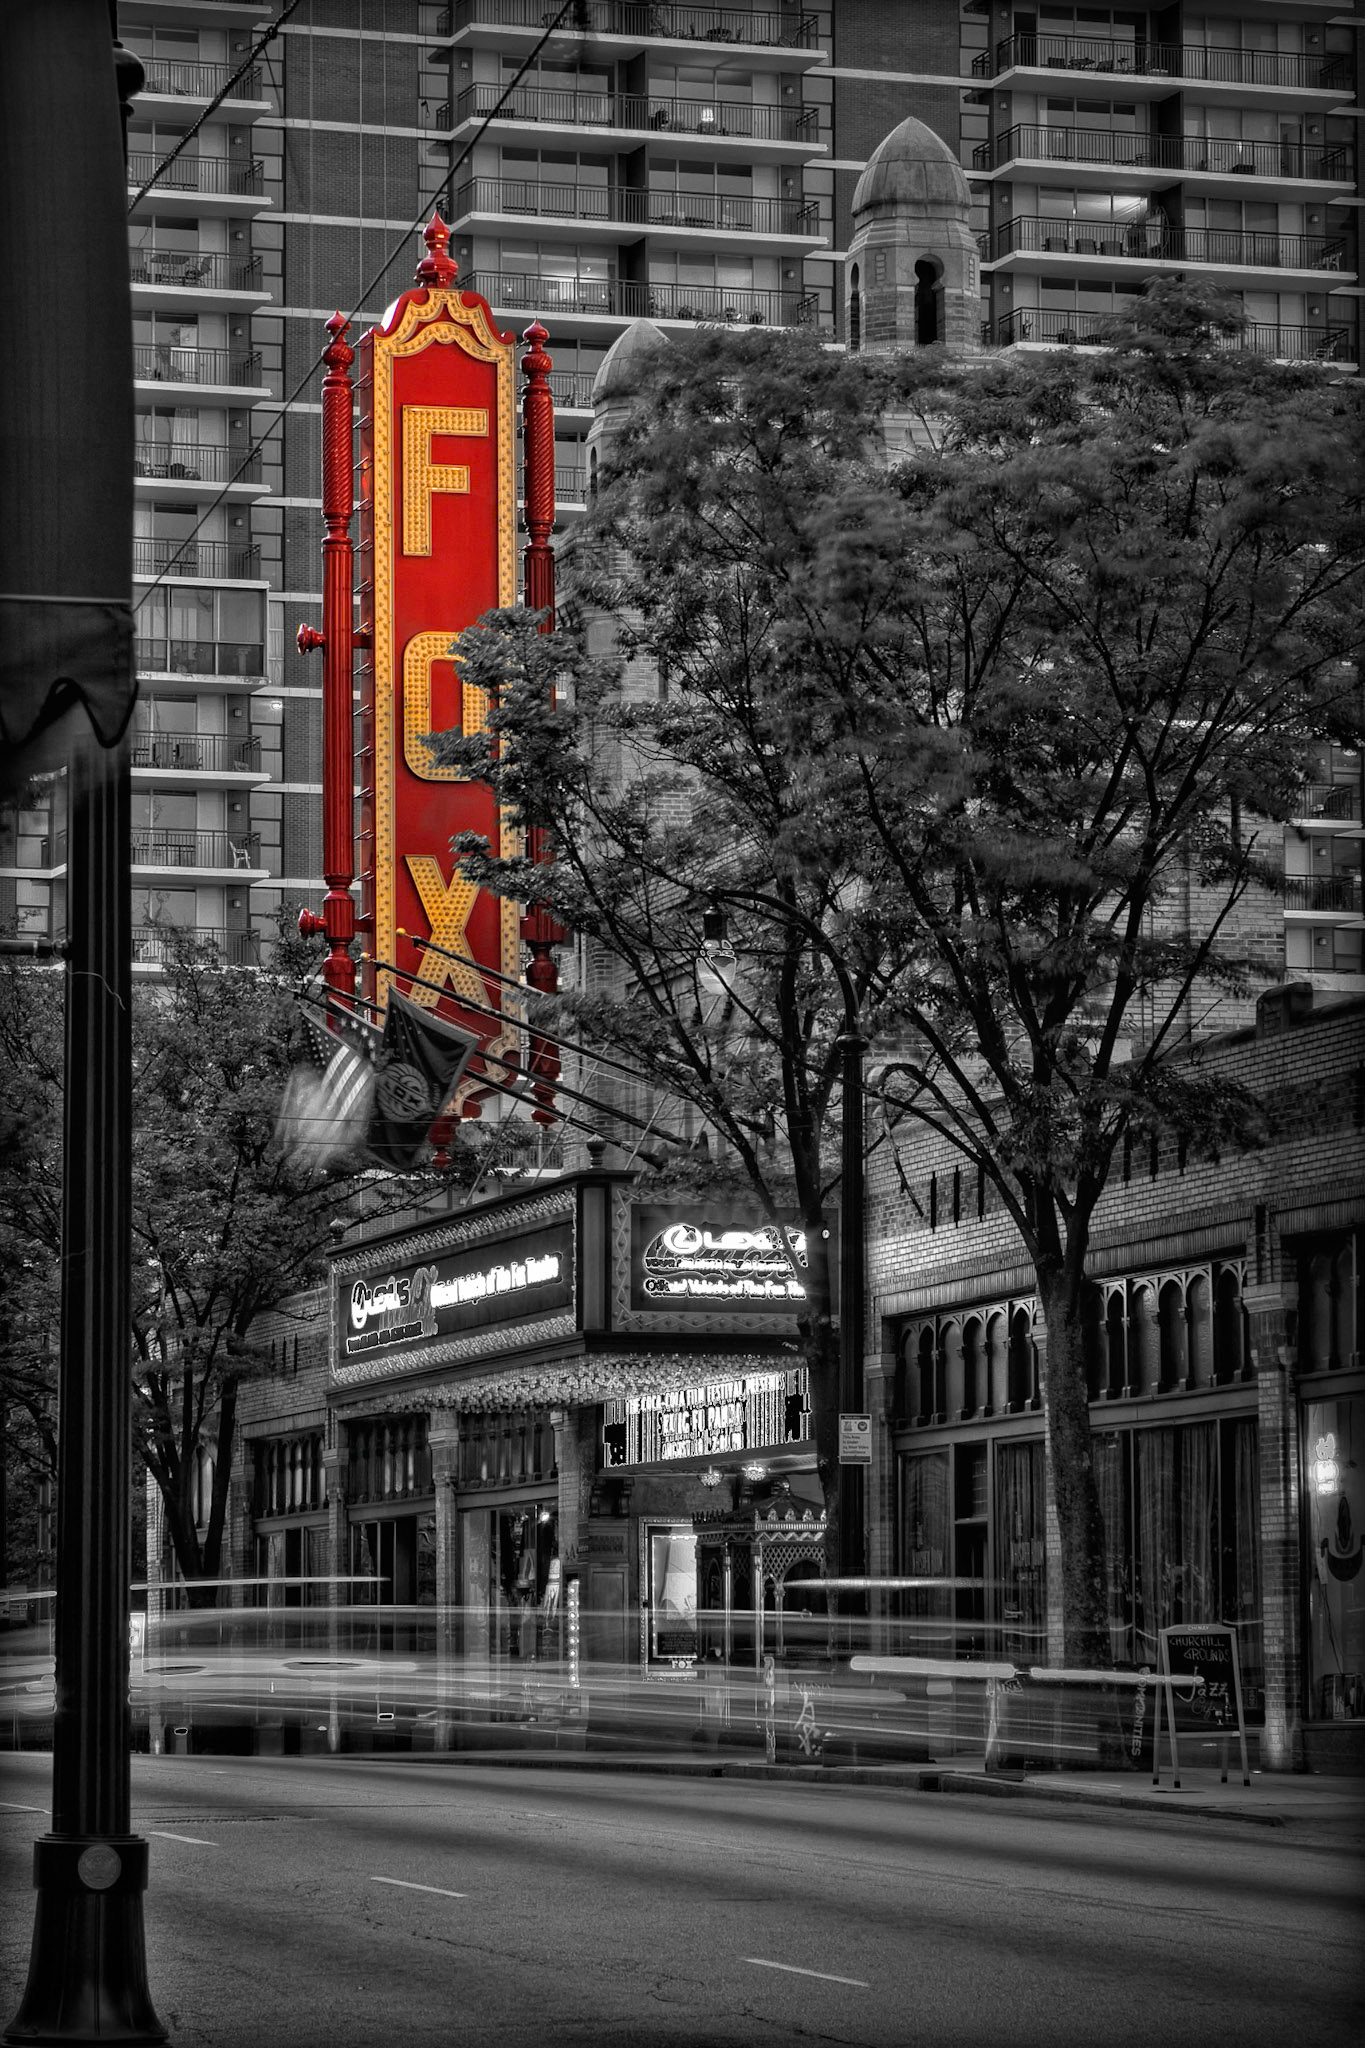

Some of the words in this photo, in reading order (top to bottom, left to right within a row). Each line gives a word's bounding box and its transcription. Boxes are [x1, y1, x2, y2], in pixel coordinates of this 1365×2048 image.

[402, 405, 492, 1010] FOX
[366, 1279, 410, 1316] LEXUS
[1169, 1636, 1225, 1648] CHURCHILL
[1183, 1648, 1231, 1662] GROUNDS
[671, 1660, 693, 1669] FOX
